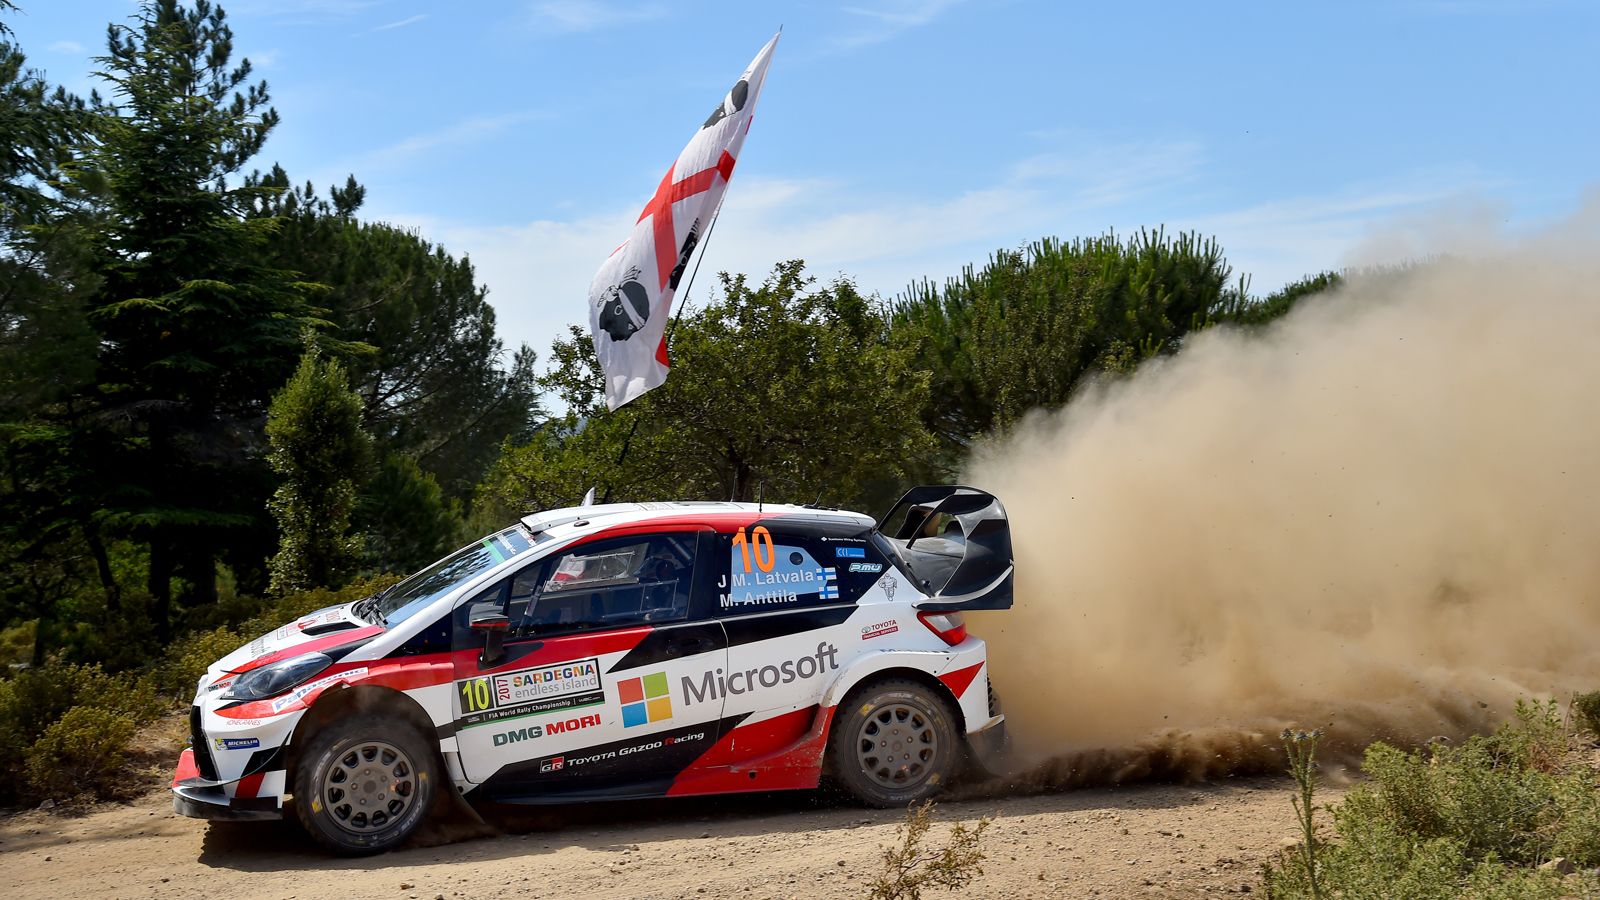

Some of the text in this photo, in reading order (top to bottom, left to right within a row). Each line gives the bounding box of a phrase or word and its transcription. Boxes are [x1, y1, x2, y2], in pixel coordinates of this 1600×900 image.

[732, 525, 775, 573] 10
[717, 570, 814, 588] J M. Latvala
[719, 589, 797, 607] M. Anttila
[871, 619, 897, 630] TOYOTA
[513, 664, 595, 688] SARDEGNA
[681, 642, 838, 706] Microsoft
[462, 678, 490, 711] 10
[497, 679, 510, 701] 2017
[515, 675, 597, 699] endless island
[499, 709, 516, 717] World
[517, 707, 531, 716] Rally
[532, 701, 571, 712] Championship
[492, 713, 602, 746] DMG MORI
[541, 731, 704, 772] GR TOYOTA GAZOO Racing
